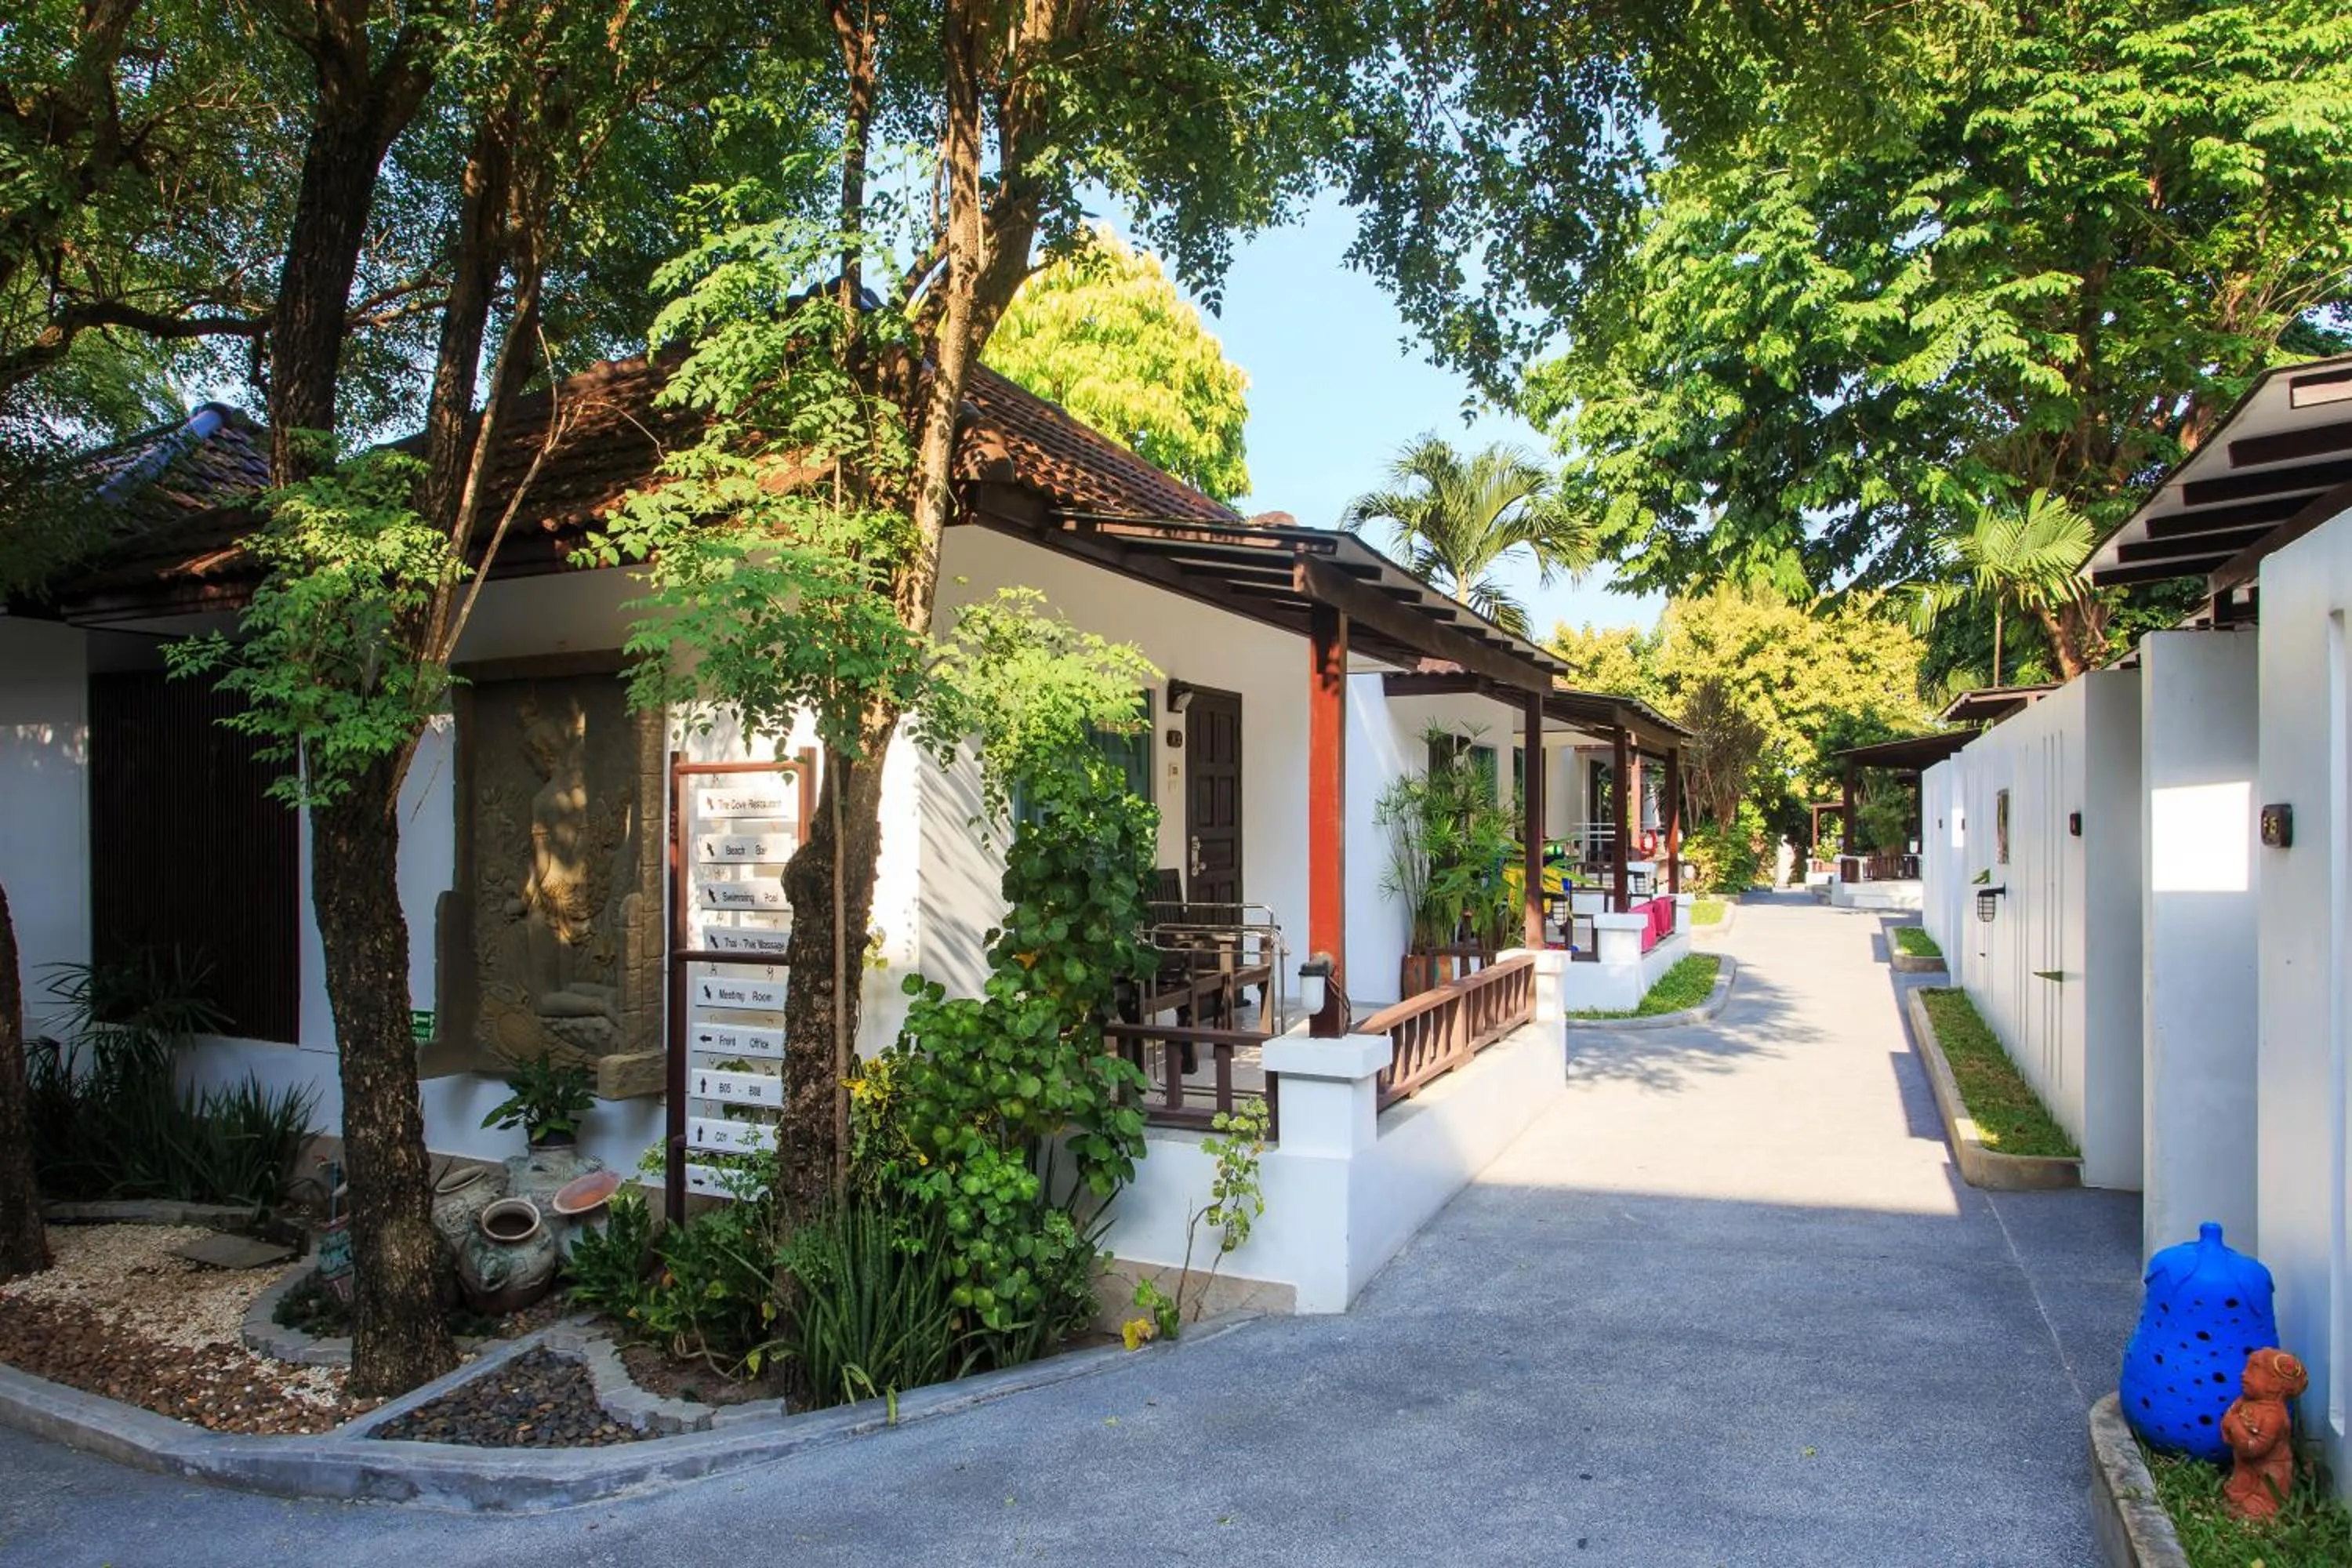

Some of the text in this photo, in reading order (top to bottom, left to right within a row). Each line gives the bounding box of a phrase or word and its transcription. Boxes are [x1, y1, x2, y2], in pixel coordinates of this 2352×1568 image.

[725, 844, 768, 855] Beach Bar
[722, 891, 778, 905] Swimming Pool
[719, 989, 772, 1003] Meeting Room
[719, 1035, 769, 1049] Front Office
